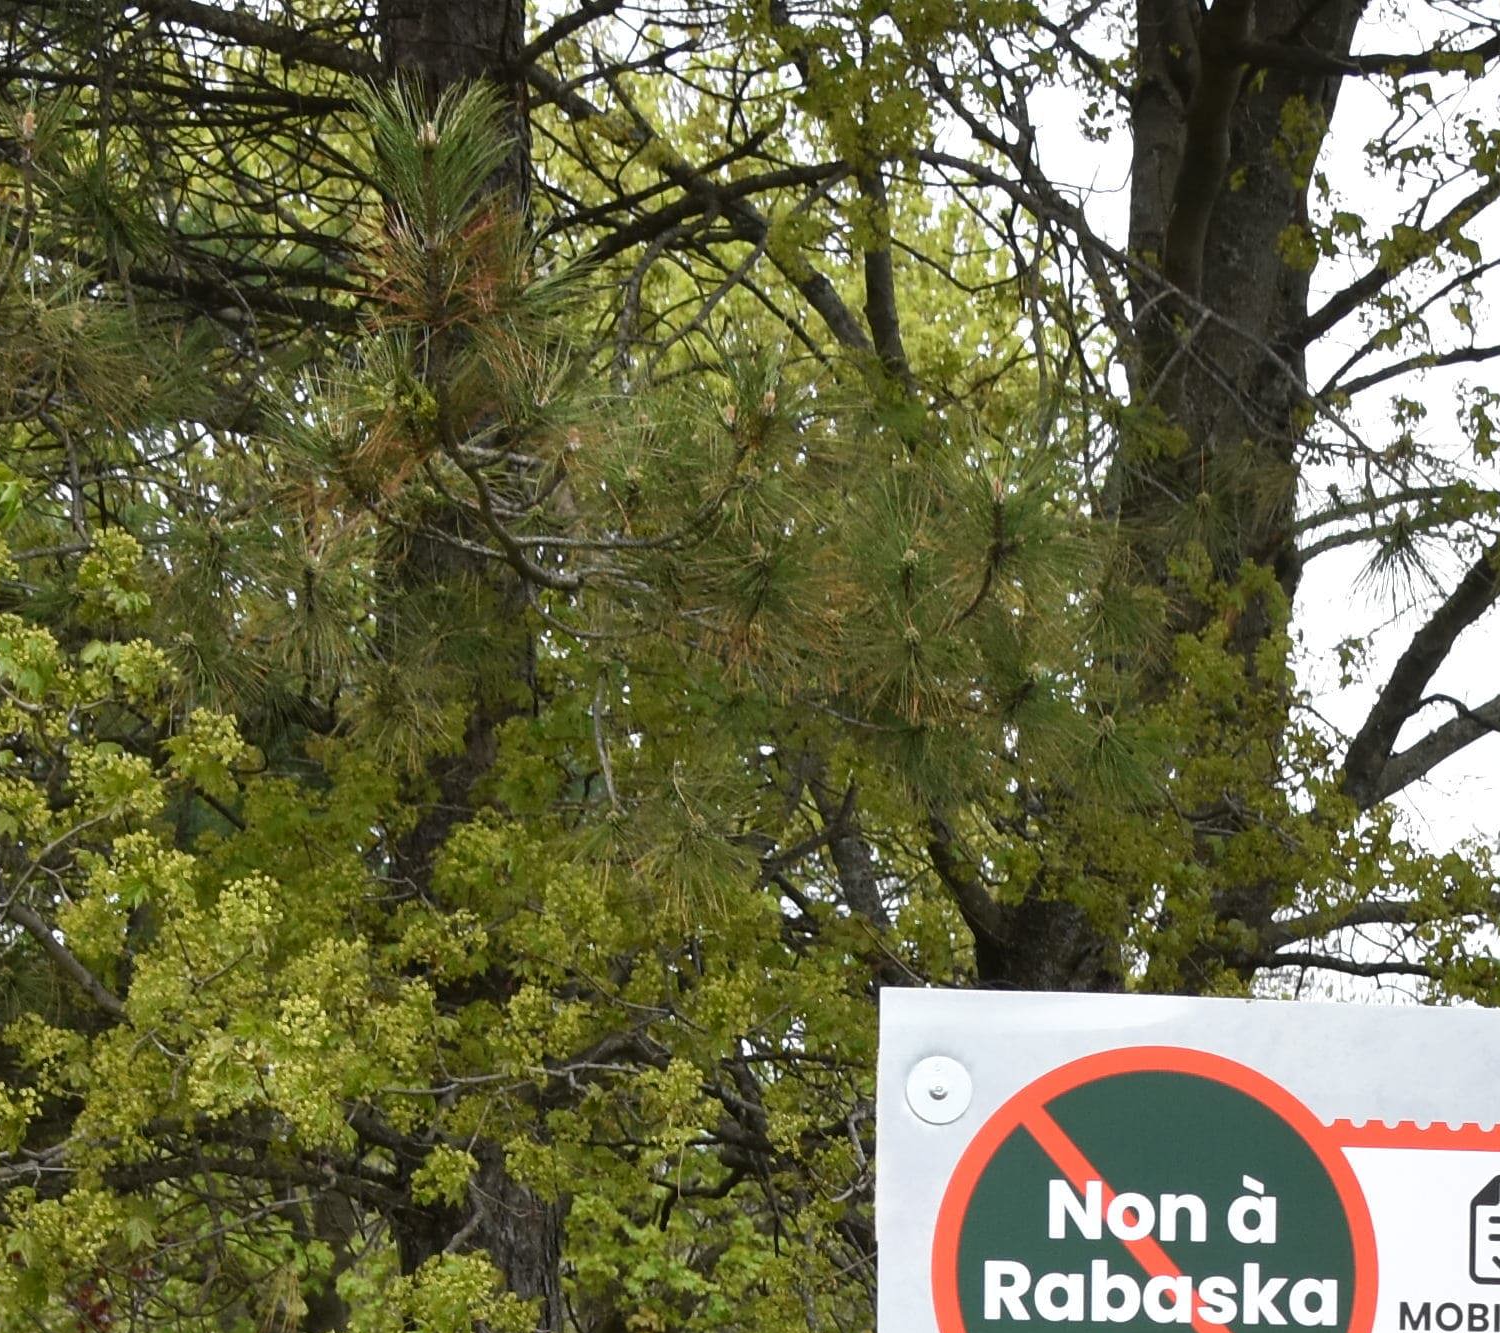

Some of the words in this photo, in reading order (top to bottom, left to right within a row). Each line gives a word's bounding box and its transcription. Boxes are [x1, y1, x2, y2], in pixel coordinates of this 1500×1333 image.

[1049, 1179, 1206, 1242] Non
[1227, 1175, 1276, 1244] à
[984, 1259, 1337, 1326] Rabaska
